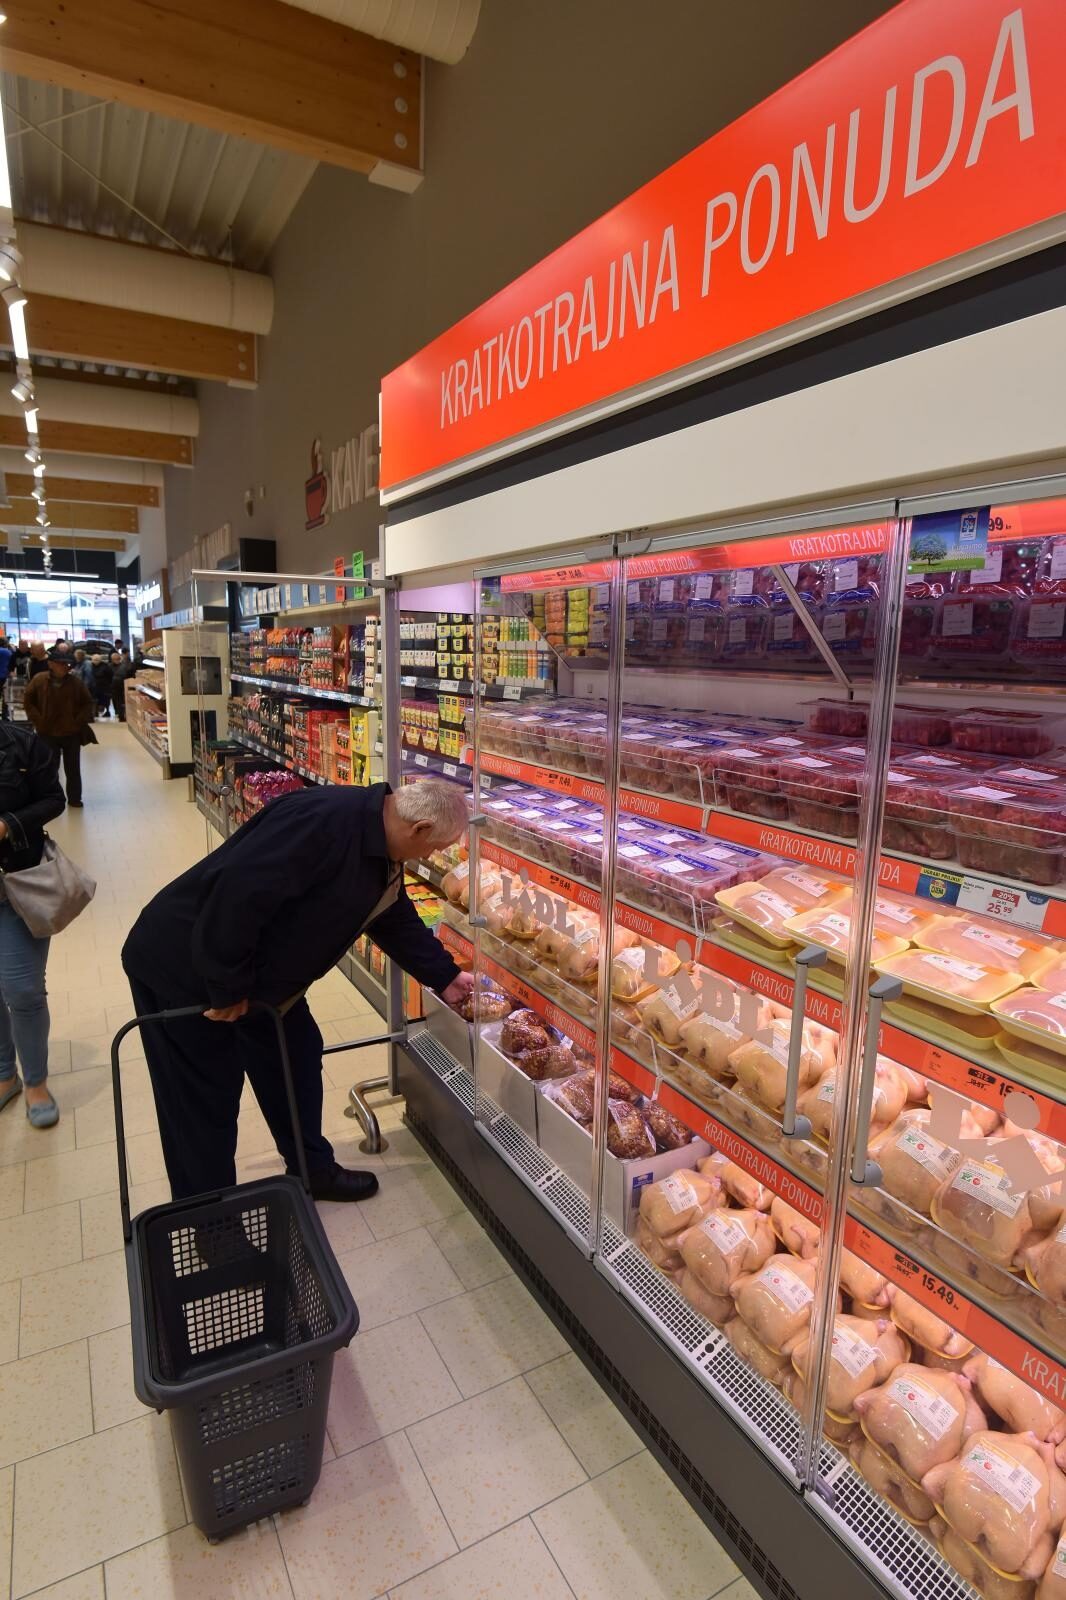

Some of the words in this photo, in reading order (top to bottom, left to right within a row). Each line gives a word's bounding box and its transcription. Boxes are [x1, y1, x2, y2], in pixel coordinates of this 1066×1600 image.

[440, 224, 680, 429] KRATKOTRAJNA
[701, 8, 1035, 298] PONUDA
[789, 528, 885, 557] KRATKOTRAJNA
[630, 796, 660, 816] PONUDA
[759, 831, 841, 869] KRATKOTRAJNA
[625, 911, 653, 936] PONUDA
[704, 1119, 777, 1187] KRATKOTRAJNA
[922, 1274, 955, 1305] 15.49
